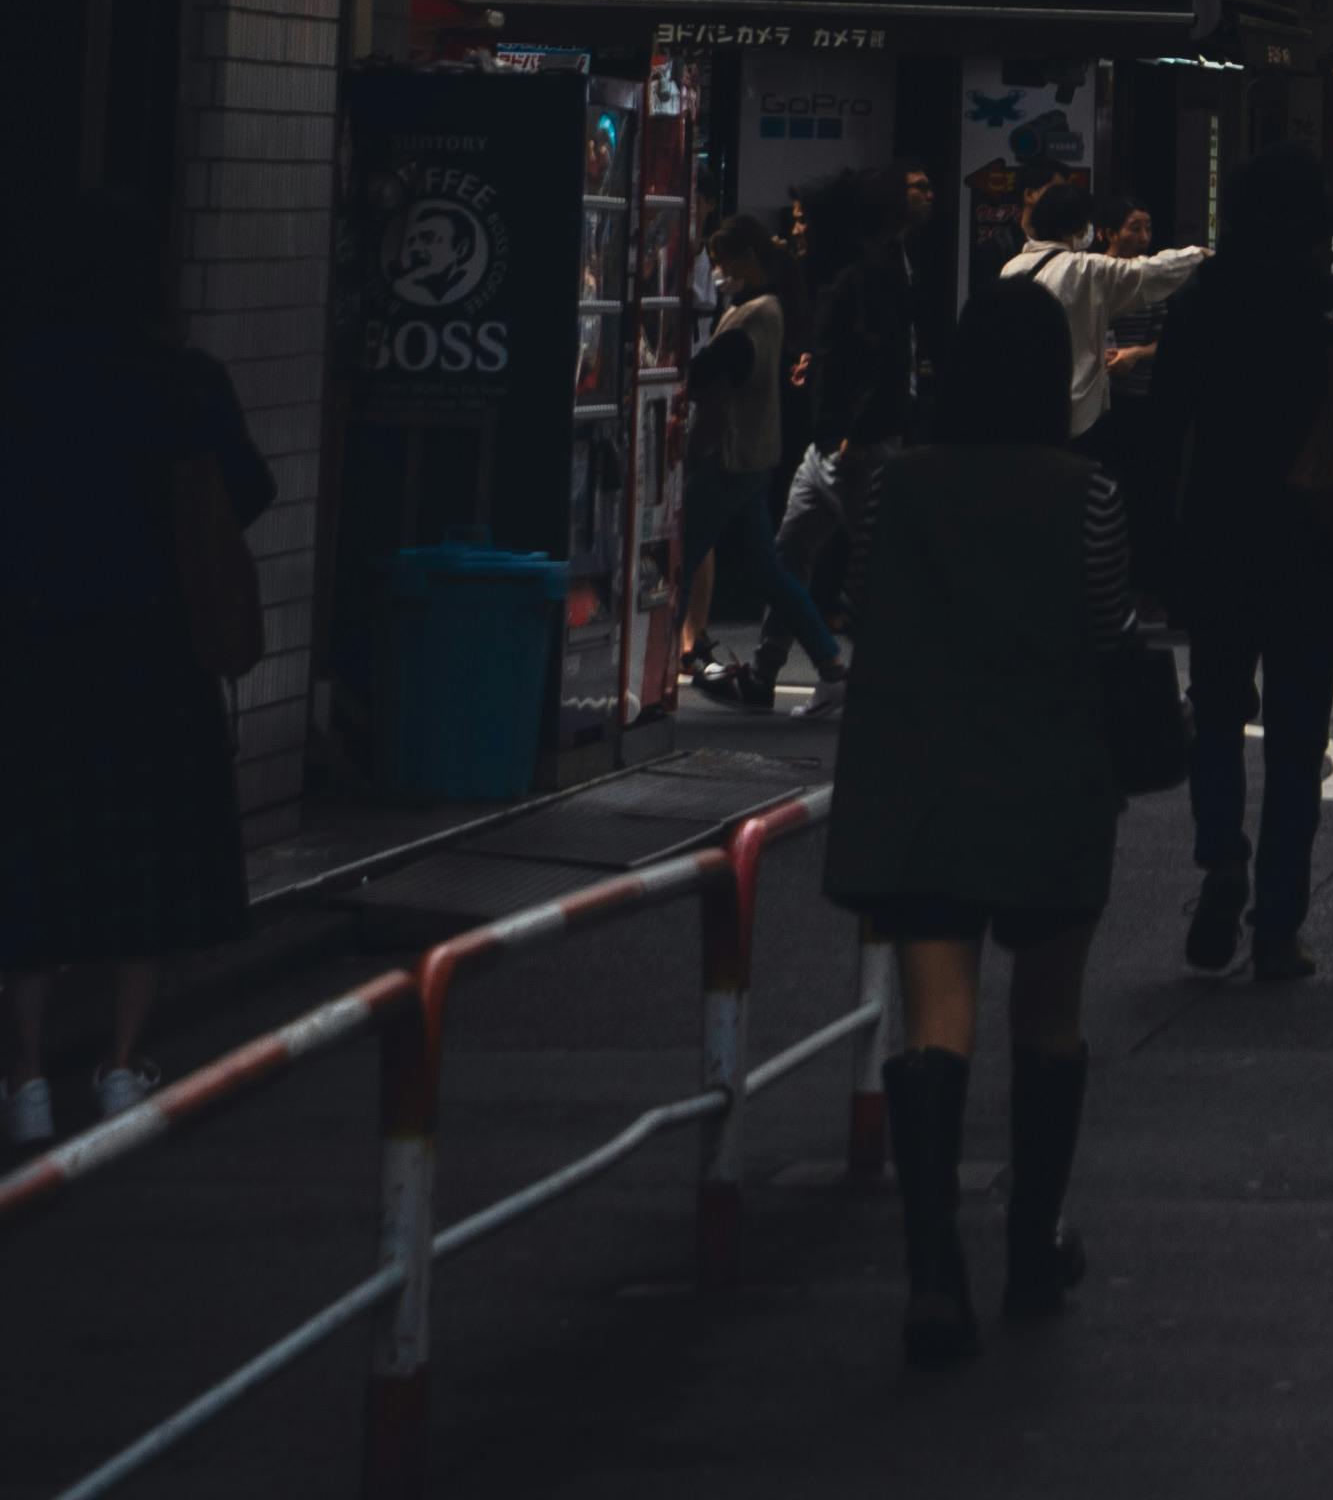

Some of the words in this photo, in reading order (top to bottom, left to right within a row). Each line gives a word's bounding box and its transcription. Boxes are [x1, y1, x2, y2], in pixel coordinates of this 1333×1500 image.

[656, 22, 793, 46] ヨドバシカメラ
[760, 91, 874, 119] GoPro
